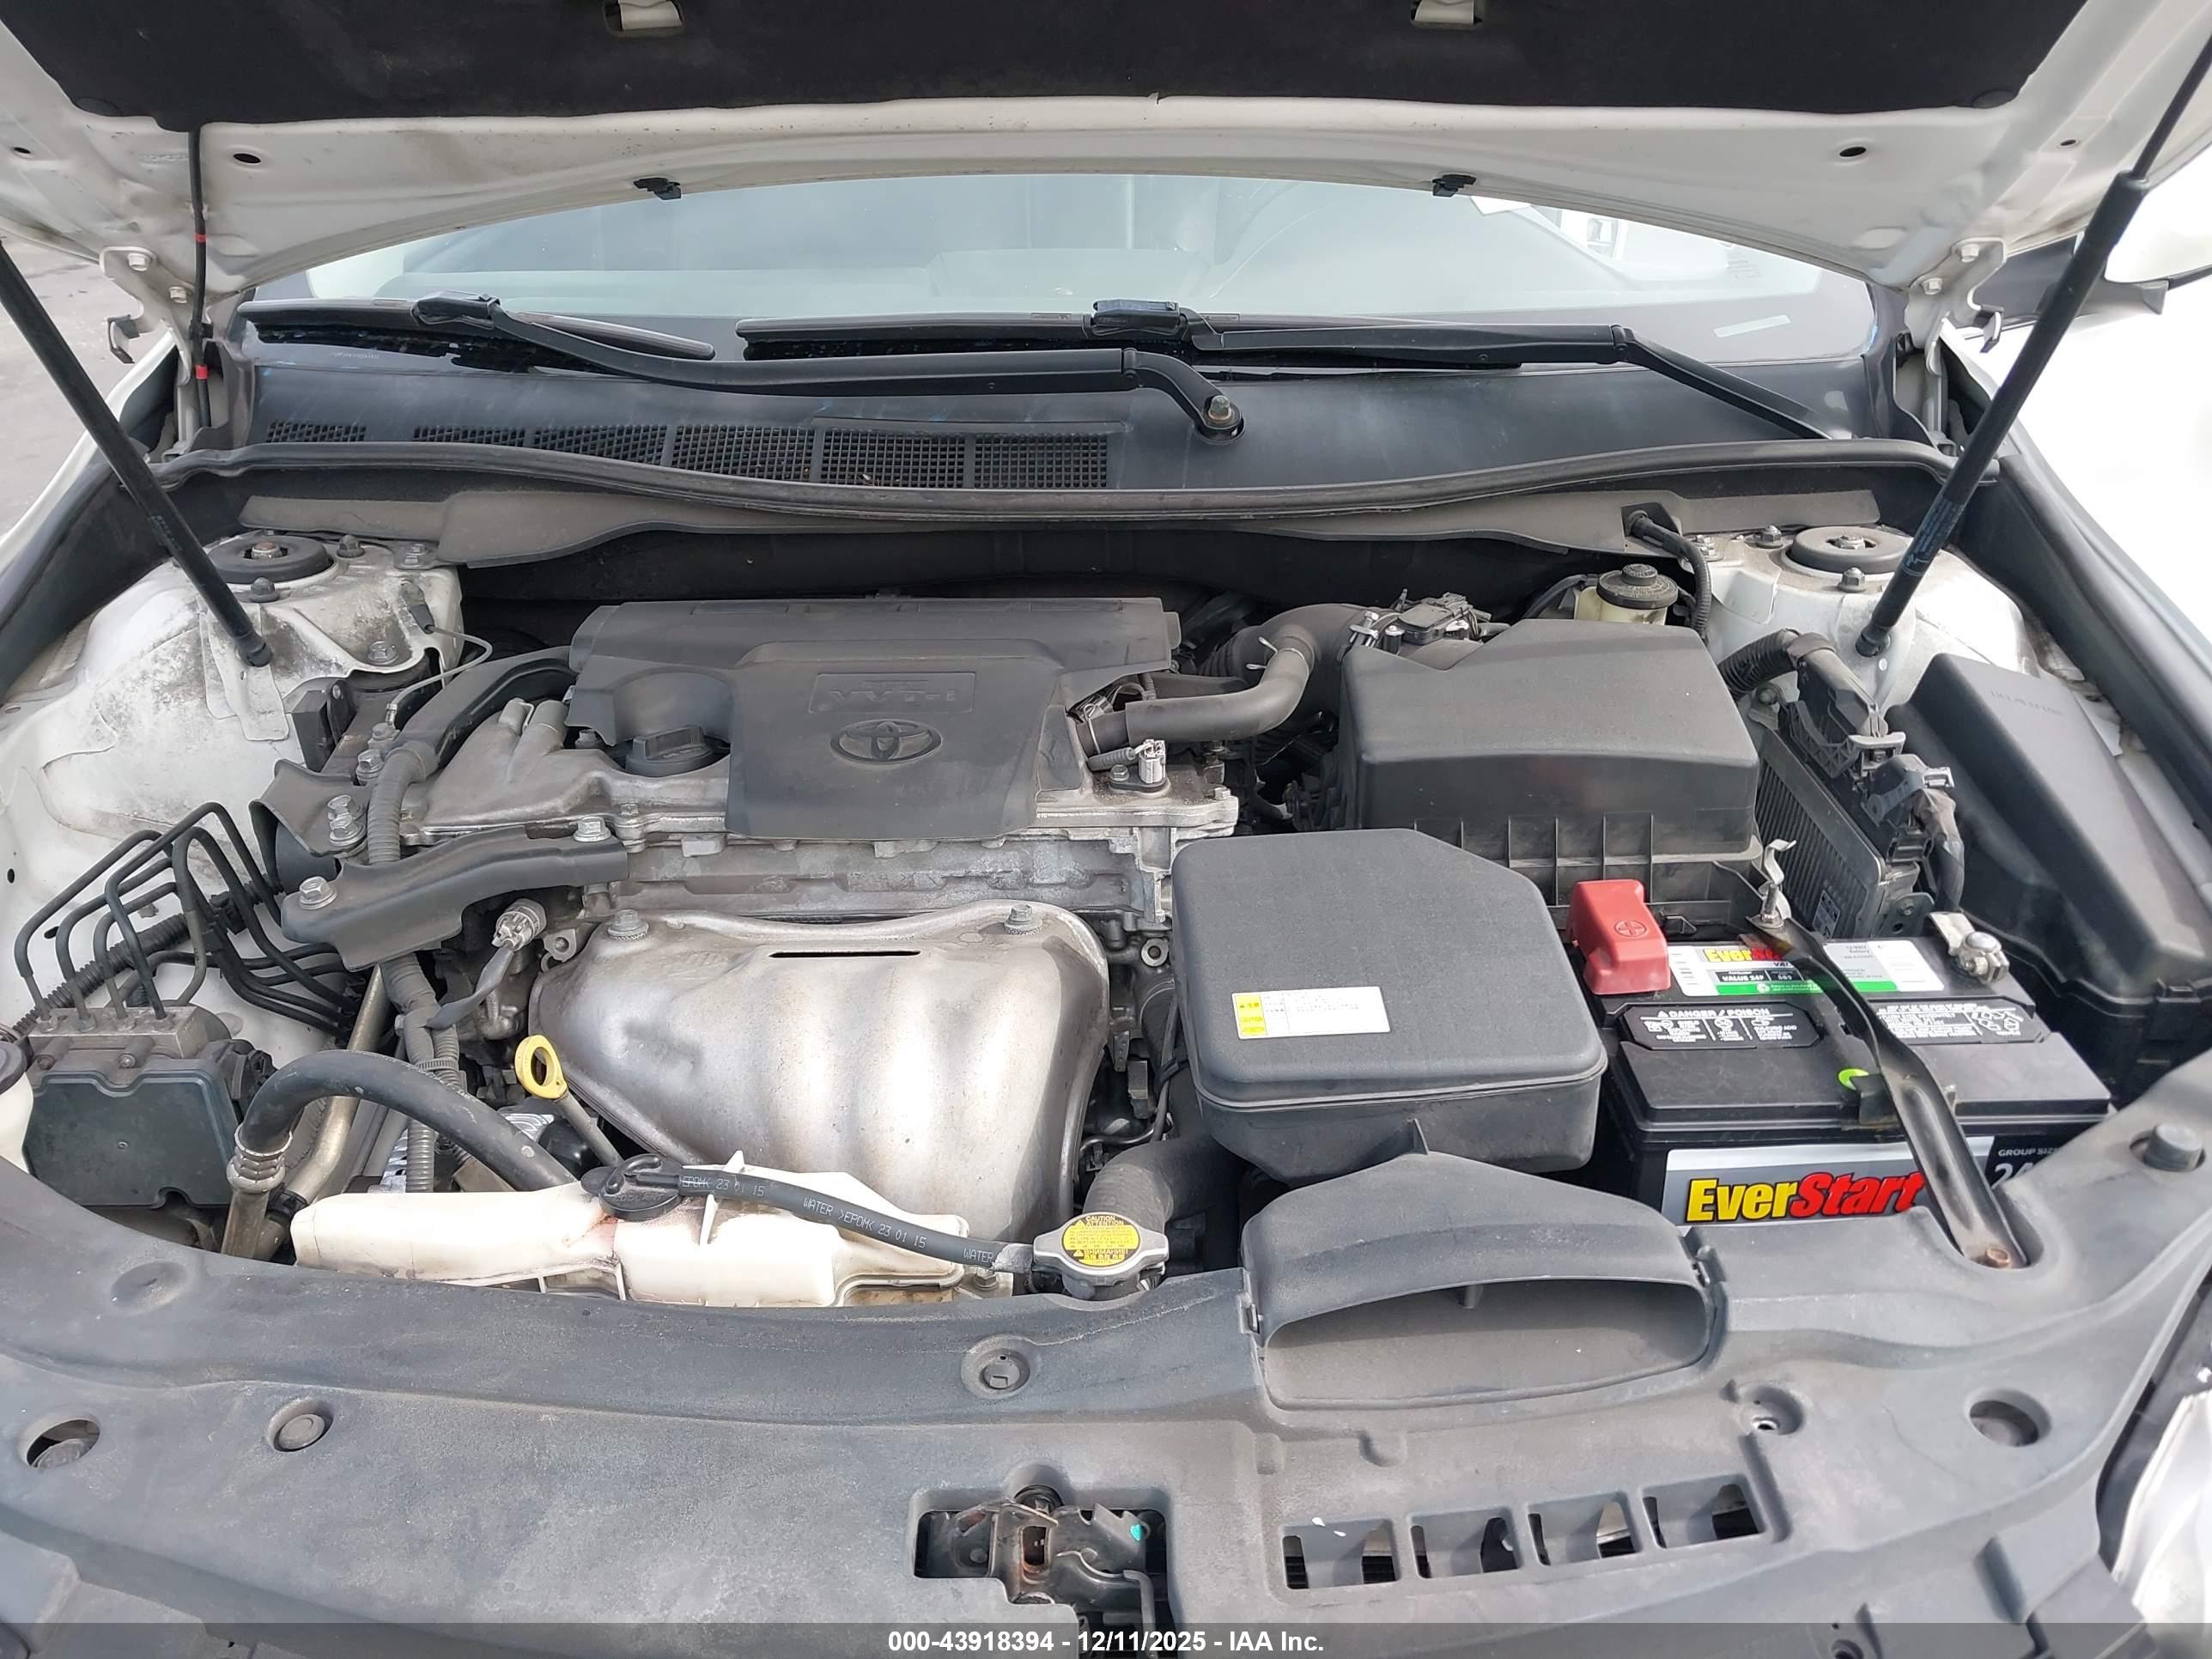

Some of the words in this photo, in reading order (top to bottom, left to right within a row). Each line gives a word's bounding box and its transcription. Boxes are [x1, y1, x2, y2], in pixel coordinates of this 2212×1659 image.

[1705, 948, 1786, 962] EverSt
[1668, 1009, 1717, 1018] DANGER
[1727, 1008, 1770, 1017] POISON
[1997, 1148, 2036, 1157] GROUP
[715, 1178, 730, 1190] 23
[752, 1185, 767, 1197] 15
[1685, 1170, 1926, 1223] EverStart
[803, 1196, 834, 1217] WATER
[878, 1223, 893, 1237] 23
[895, 1229, 908, 1243] 01
[914, 1235, 927, 1249] 15
[963, 1247, 994, 1263] WATER
